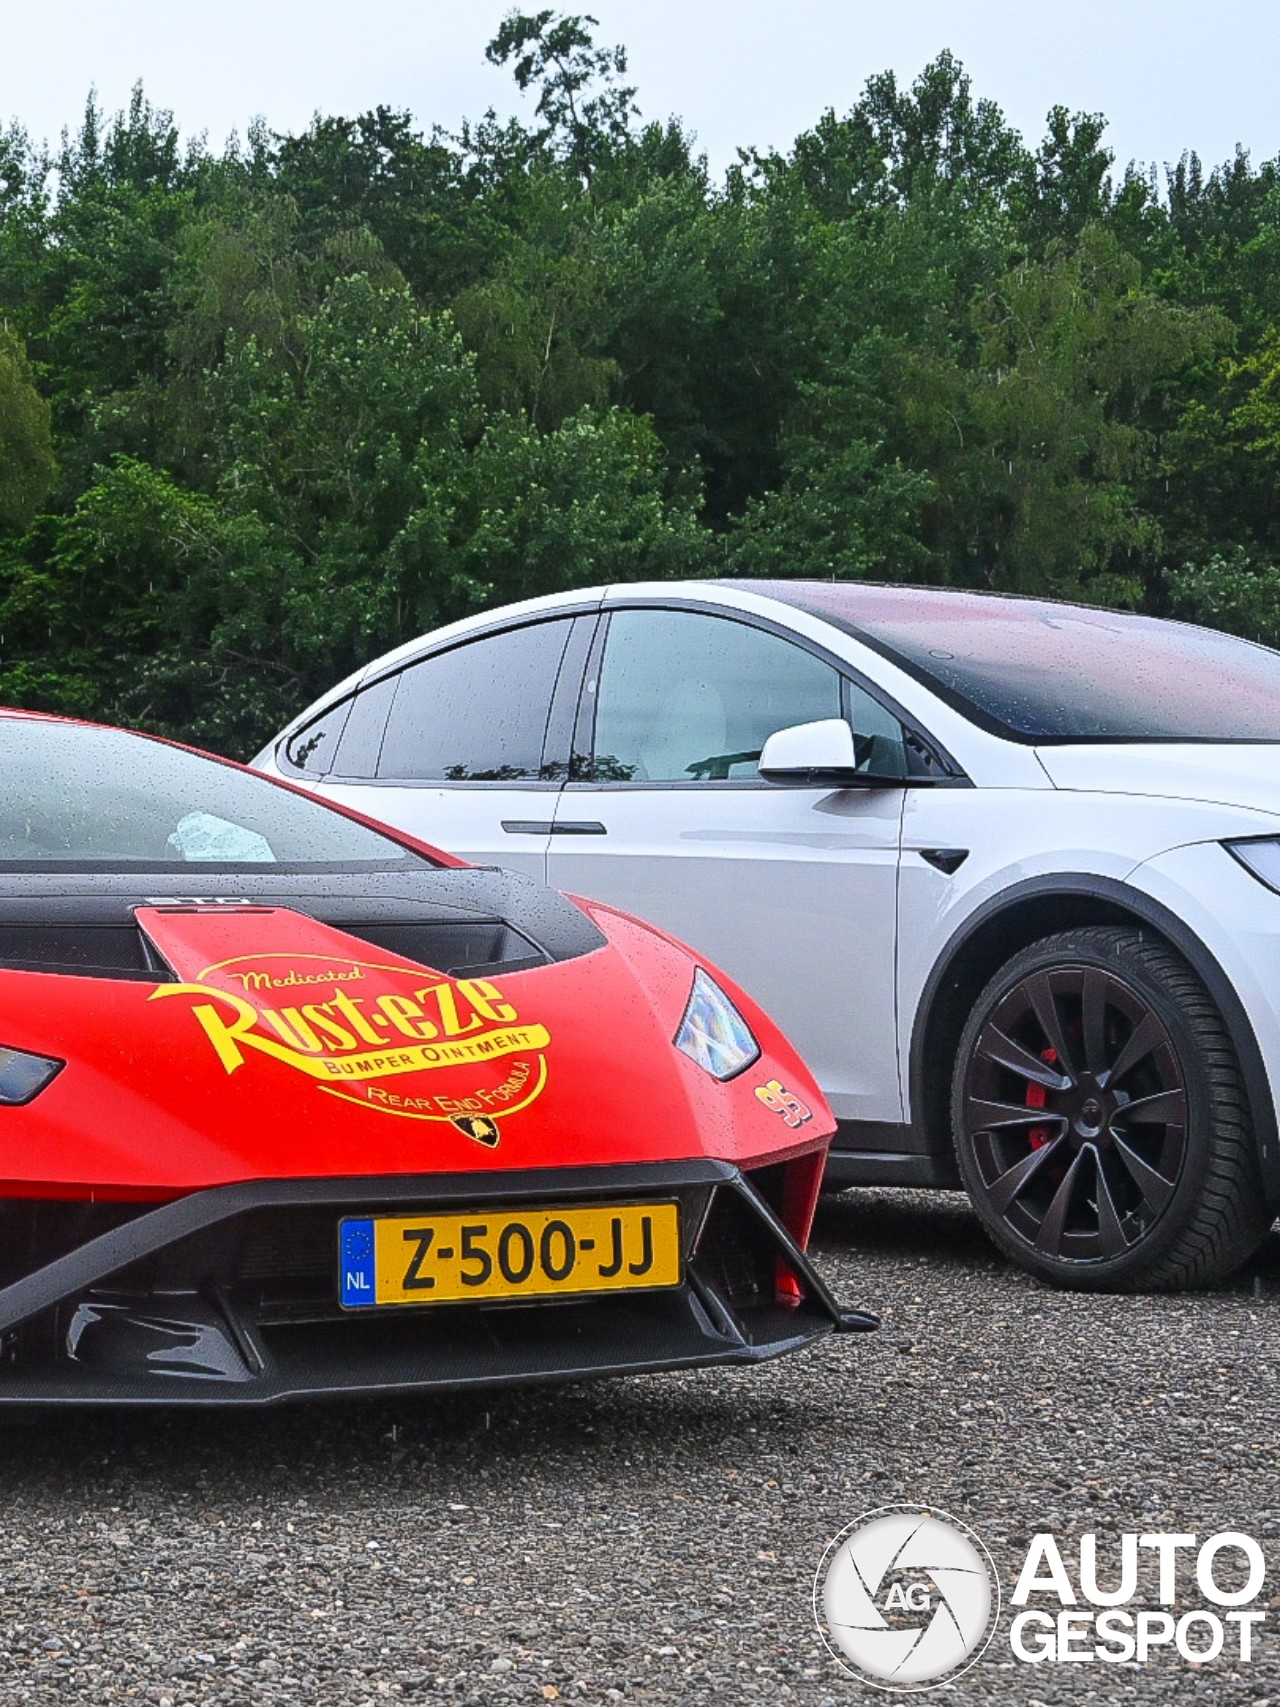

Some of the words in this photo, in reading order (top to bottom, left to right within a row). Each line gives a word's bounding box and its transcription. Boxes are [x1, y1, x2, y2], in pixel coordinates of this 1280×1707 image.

[227, 966, 366, 990] Medicated
[325, 1053, 414, 1075] BUMPER
[425, 1032, 532, 1062] OINTMENT
[367, 1086, 434, 1111] REAR
[435, 1096, 482, 1112] END
[480, 1062, 531, 1106] FORMULA
[754, 1078, 813, 1129] 95
[347, 1272, 370, 1290] NL
[403, 1217, 653, 1290] Z-500-JJ
